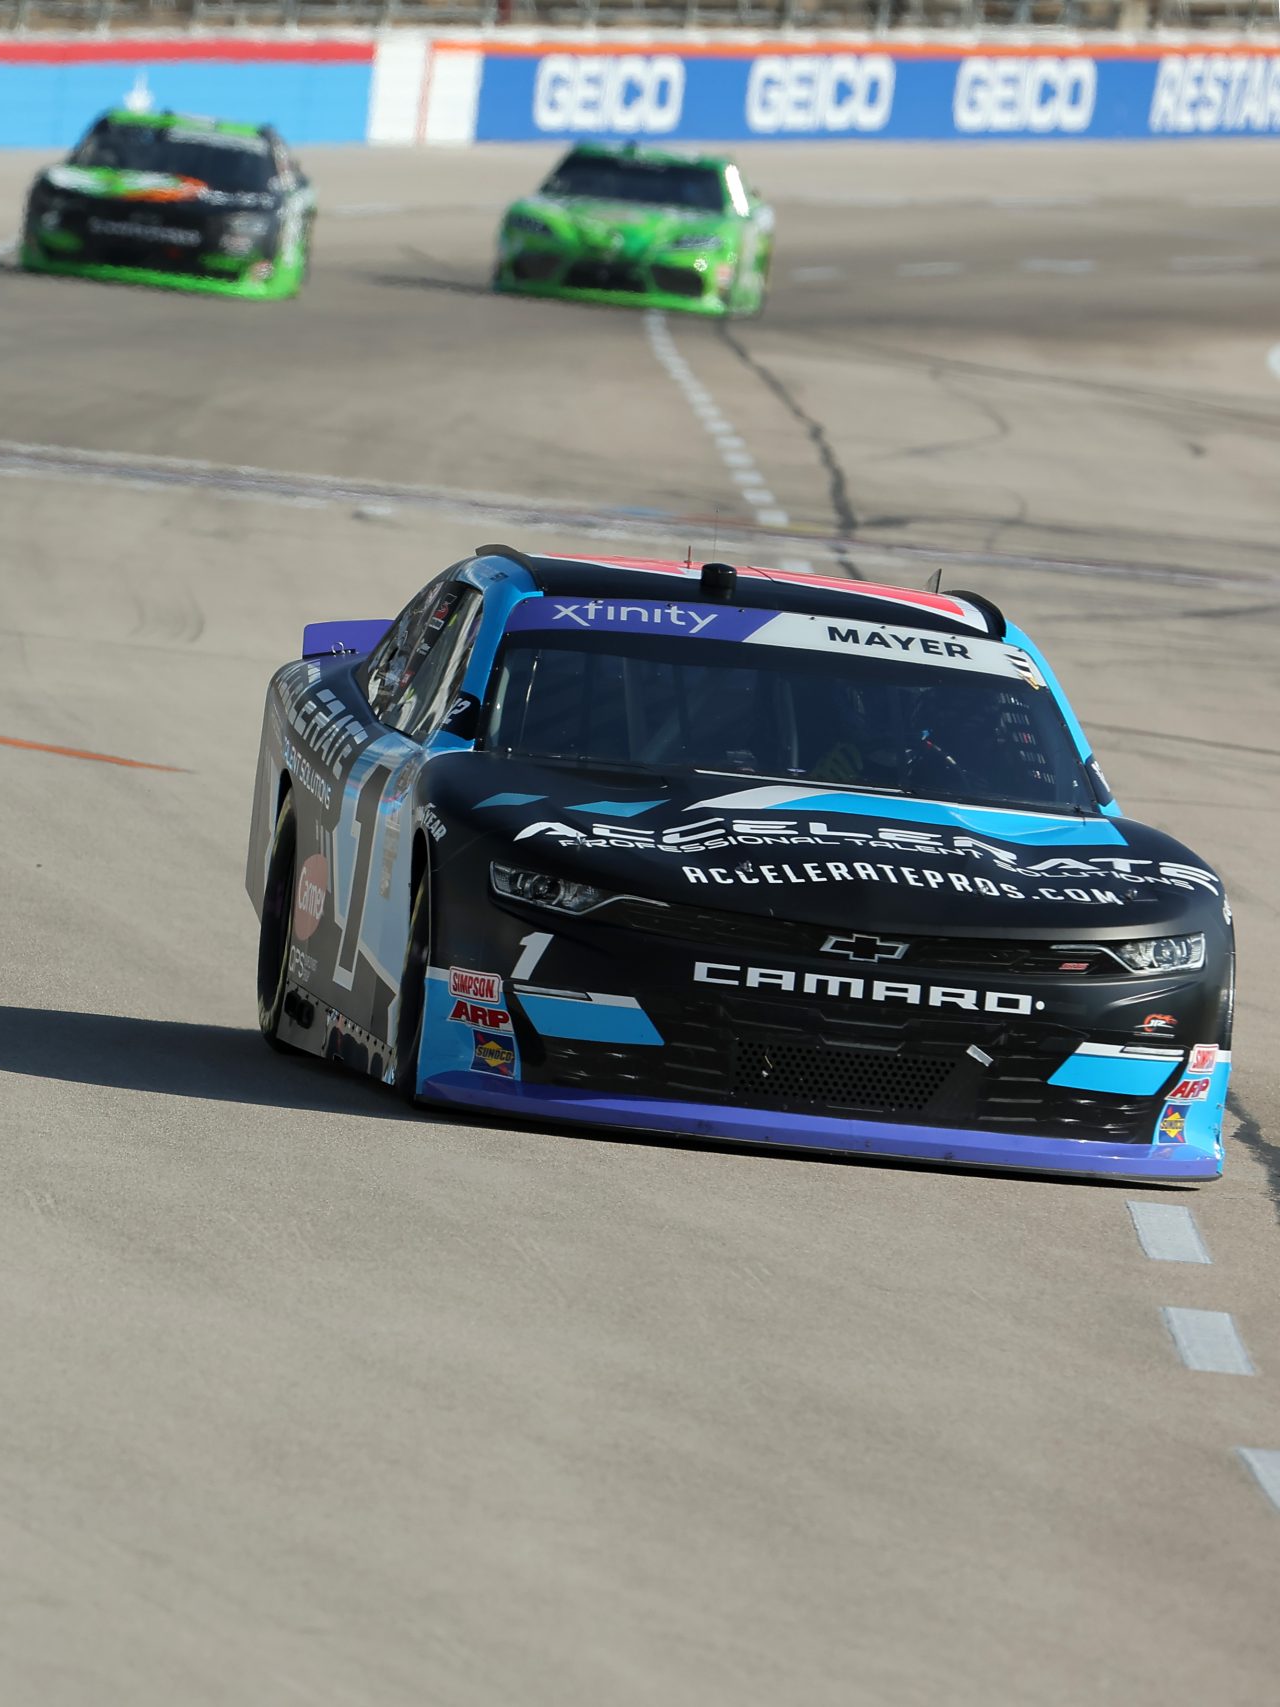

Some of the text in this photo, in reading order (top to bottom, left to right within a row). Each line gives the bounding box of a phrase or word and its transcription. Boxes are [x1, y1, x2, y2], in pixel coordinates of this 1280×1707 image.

[533, 53, 686, 135] GEICO
[746, 53, 897, 135] GEICO
[953, 53, 1098, 135] GEICO
[552, 600, 718, 635] xfinity
[827, 625, 973, 661] MAYER
[513, 817, 1220, 897] ACCELERATE
[558, 834, 1195, 891] PROFESSIONAL TALENT SOLUTIONS
[681, 861, 1125, 906] ACCELERATEPROS.COM
[510, 931, 555, 981] 1
[452, 971, 496, 999] SIMPSON
[693, 960, 1033, 1016] CAMARO
[450, 1001, 511, 1029] ARP
[476, 1045, 515, 1063] SUNOCO
